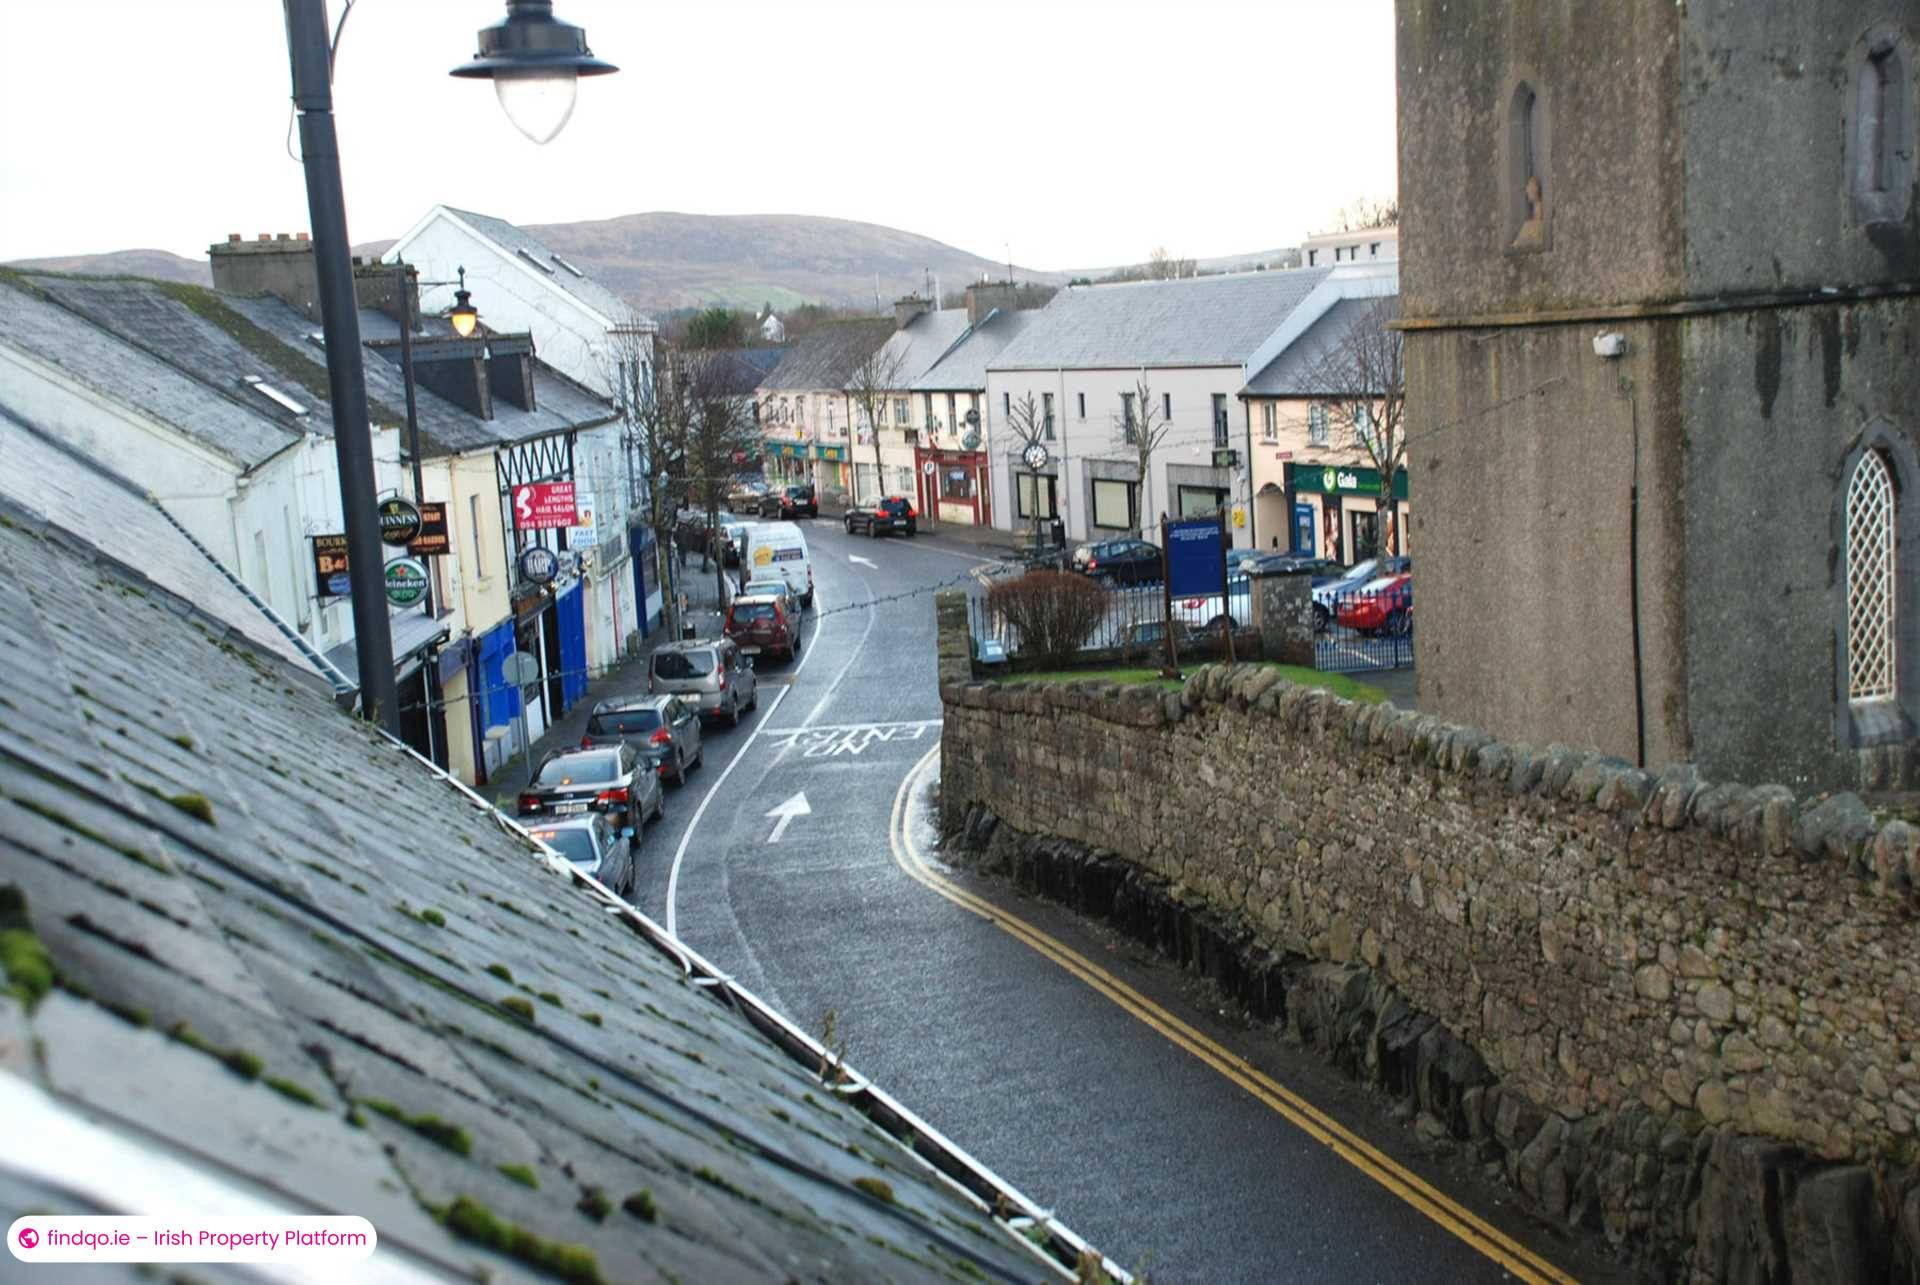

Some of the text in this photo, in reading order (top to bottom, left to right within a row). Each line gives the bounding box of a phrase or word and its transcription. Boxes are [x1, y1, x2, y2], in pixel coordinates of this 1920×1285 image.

[1337, 472, 1357, 489] Gala
[552, 503, 575, 513] SALON
[379, 513, 419, 527] UINNESS
[385, 578, 425, 588] eineken
